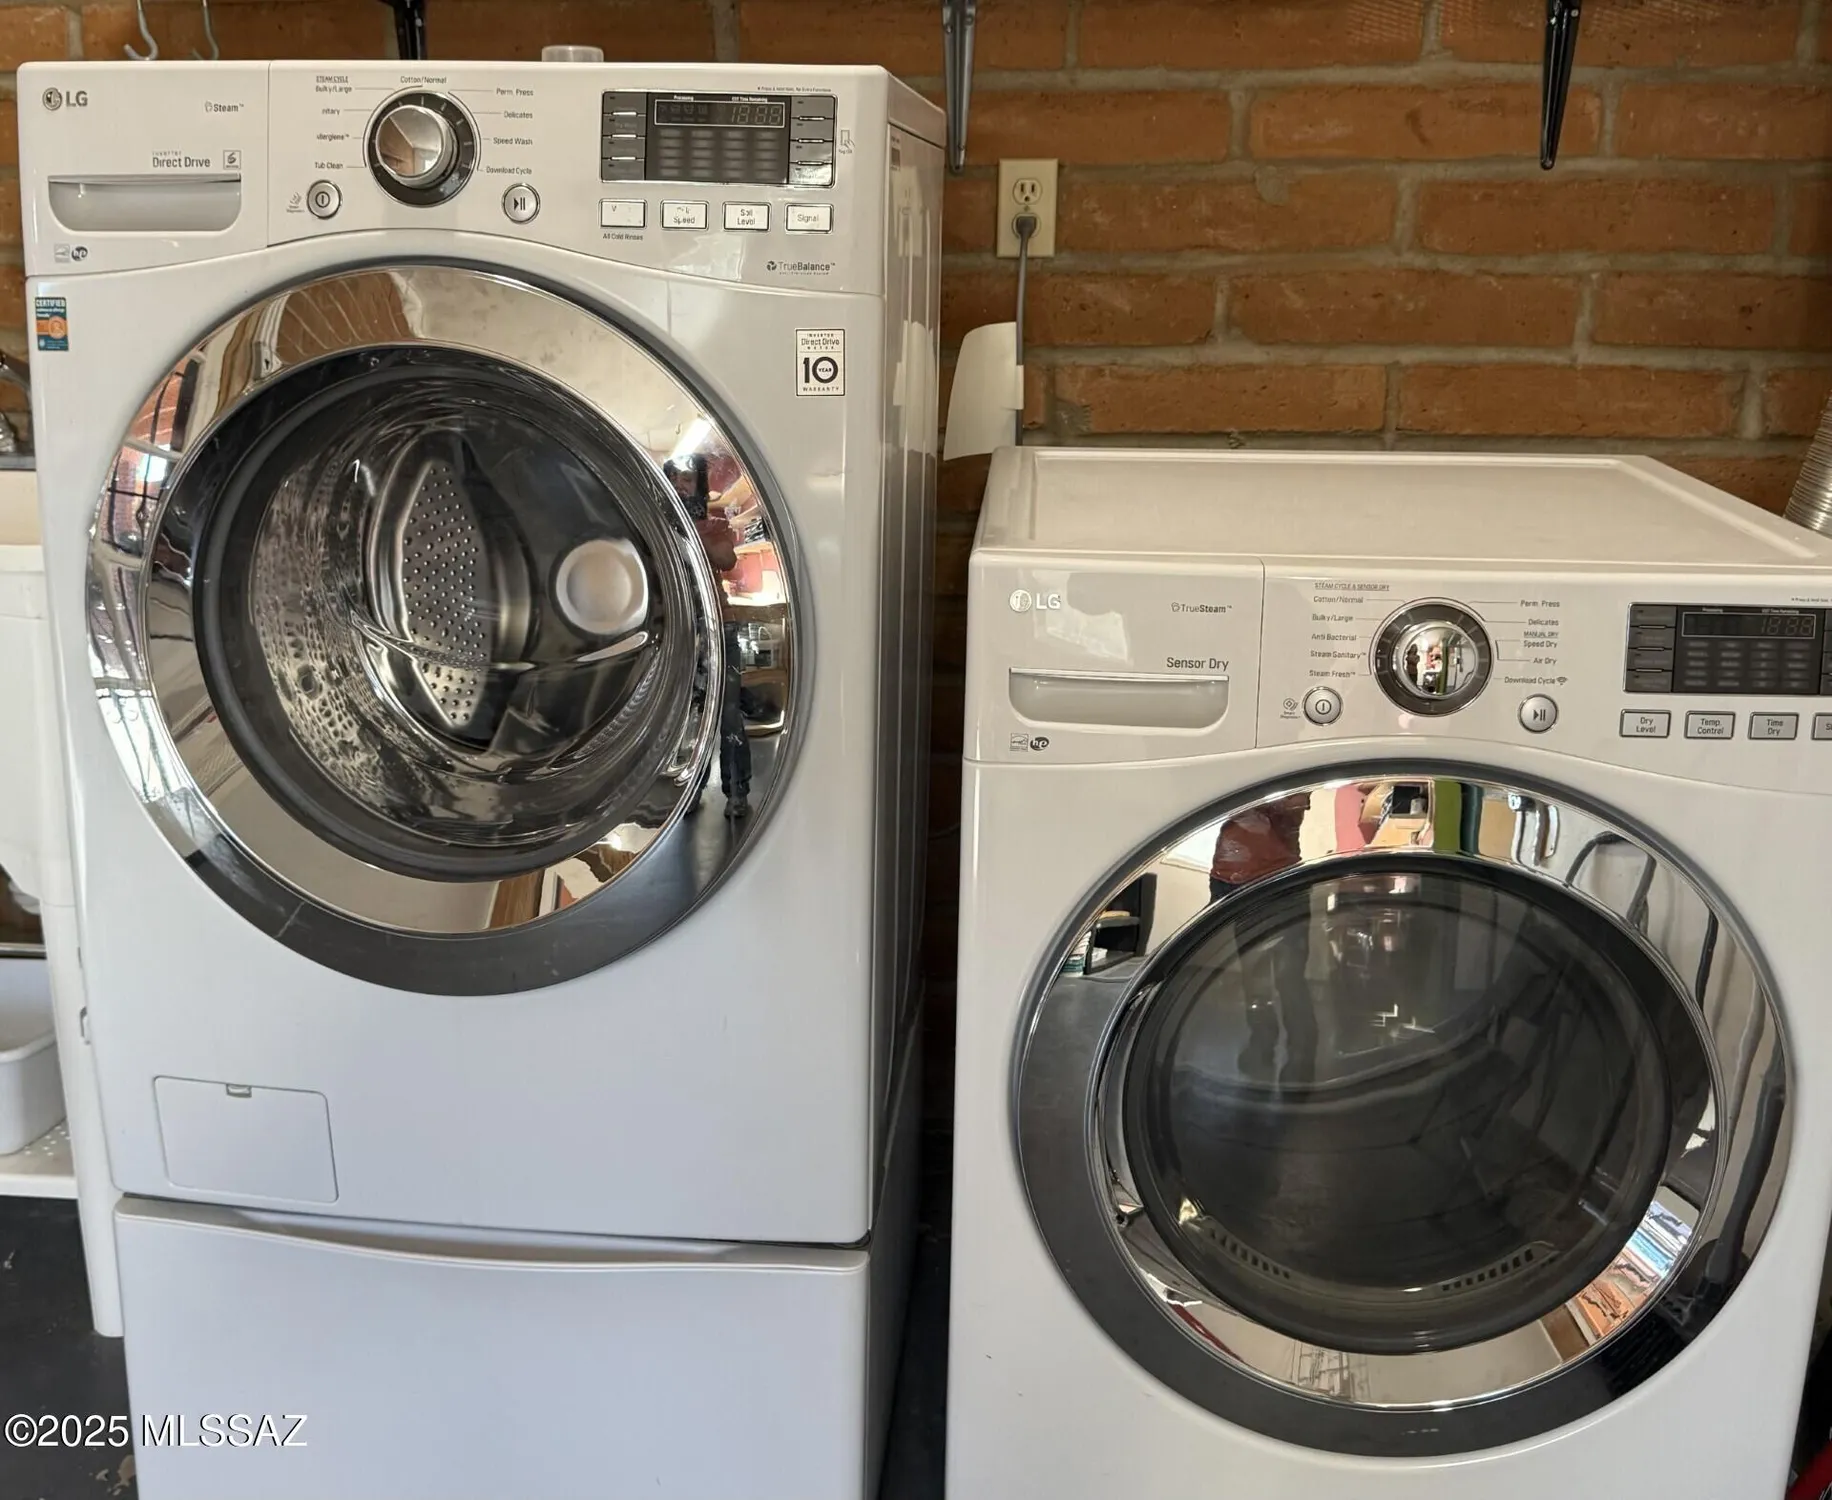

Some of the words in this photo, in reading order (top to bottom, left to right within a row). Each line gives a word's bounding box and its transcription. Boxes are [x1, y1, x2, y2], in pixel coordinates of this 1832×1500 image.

[400, 76, 447, 84] Cotton/Normal
[66, 90, 88, 107] LG
[493, 137, 513, 145] Speed
[152, 156, 182, 168] Direct
[184, 156, 211, 168] Drive
[803, 356, 839, 384] 10
[1036, 593, 1061, 610] LG
[1528, 618, 1559, 626] Delicates
[1326, 633, 1357, 641] Bacterial
[1523, 640, 1545, 648] Speed
[1546, 640, 1558, 648] Dry
[1166, 656, 1207, 669] Sensor
[1208, 657, 1230, 672] Dry
[1544, 657, 1557, 666] Dry
[1504, 676, 1537, 684] Download
[1640, 716, 1654, 726] Dry
[1766, 718, 1784, 727] Time
[1636, 725, 1657, 734] Level
[1697, 726, 1725, 735] Control
[1767, 727, 1782, 736] Dry
